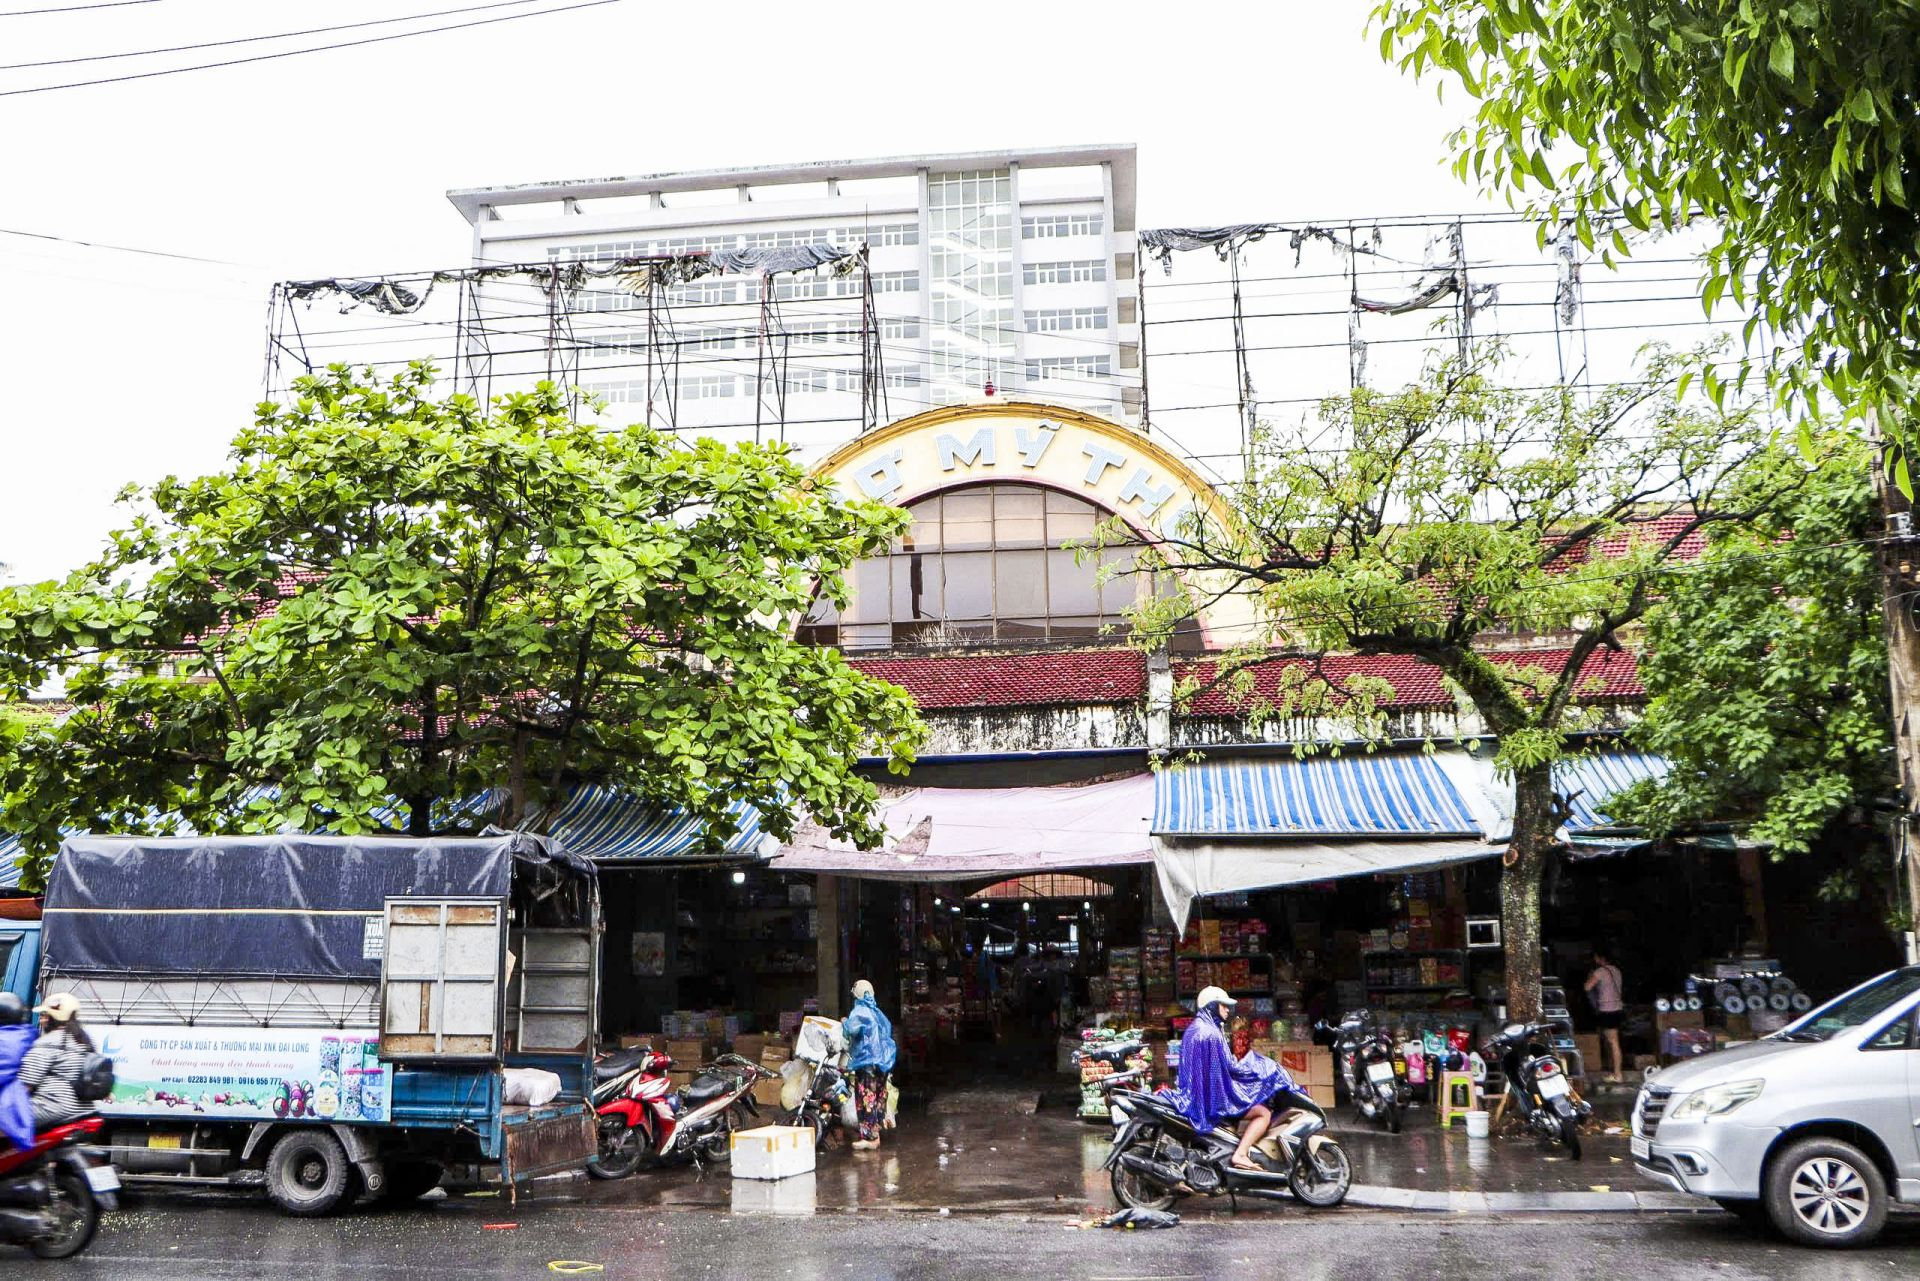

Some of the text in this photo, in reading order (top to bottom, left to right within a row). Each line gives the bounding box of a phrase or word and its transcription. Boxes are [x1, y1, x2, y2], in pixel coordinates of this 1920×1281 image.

[936, 419, 1063, 472] MỸ
[160, 1039, 168, 1050] TY
[169, 1039, 179, 1050] CP
[291, 1041, 310, 1053] LONG
[269, 1077, 282, 1086] 777
